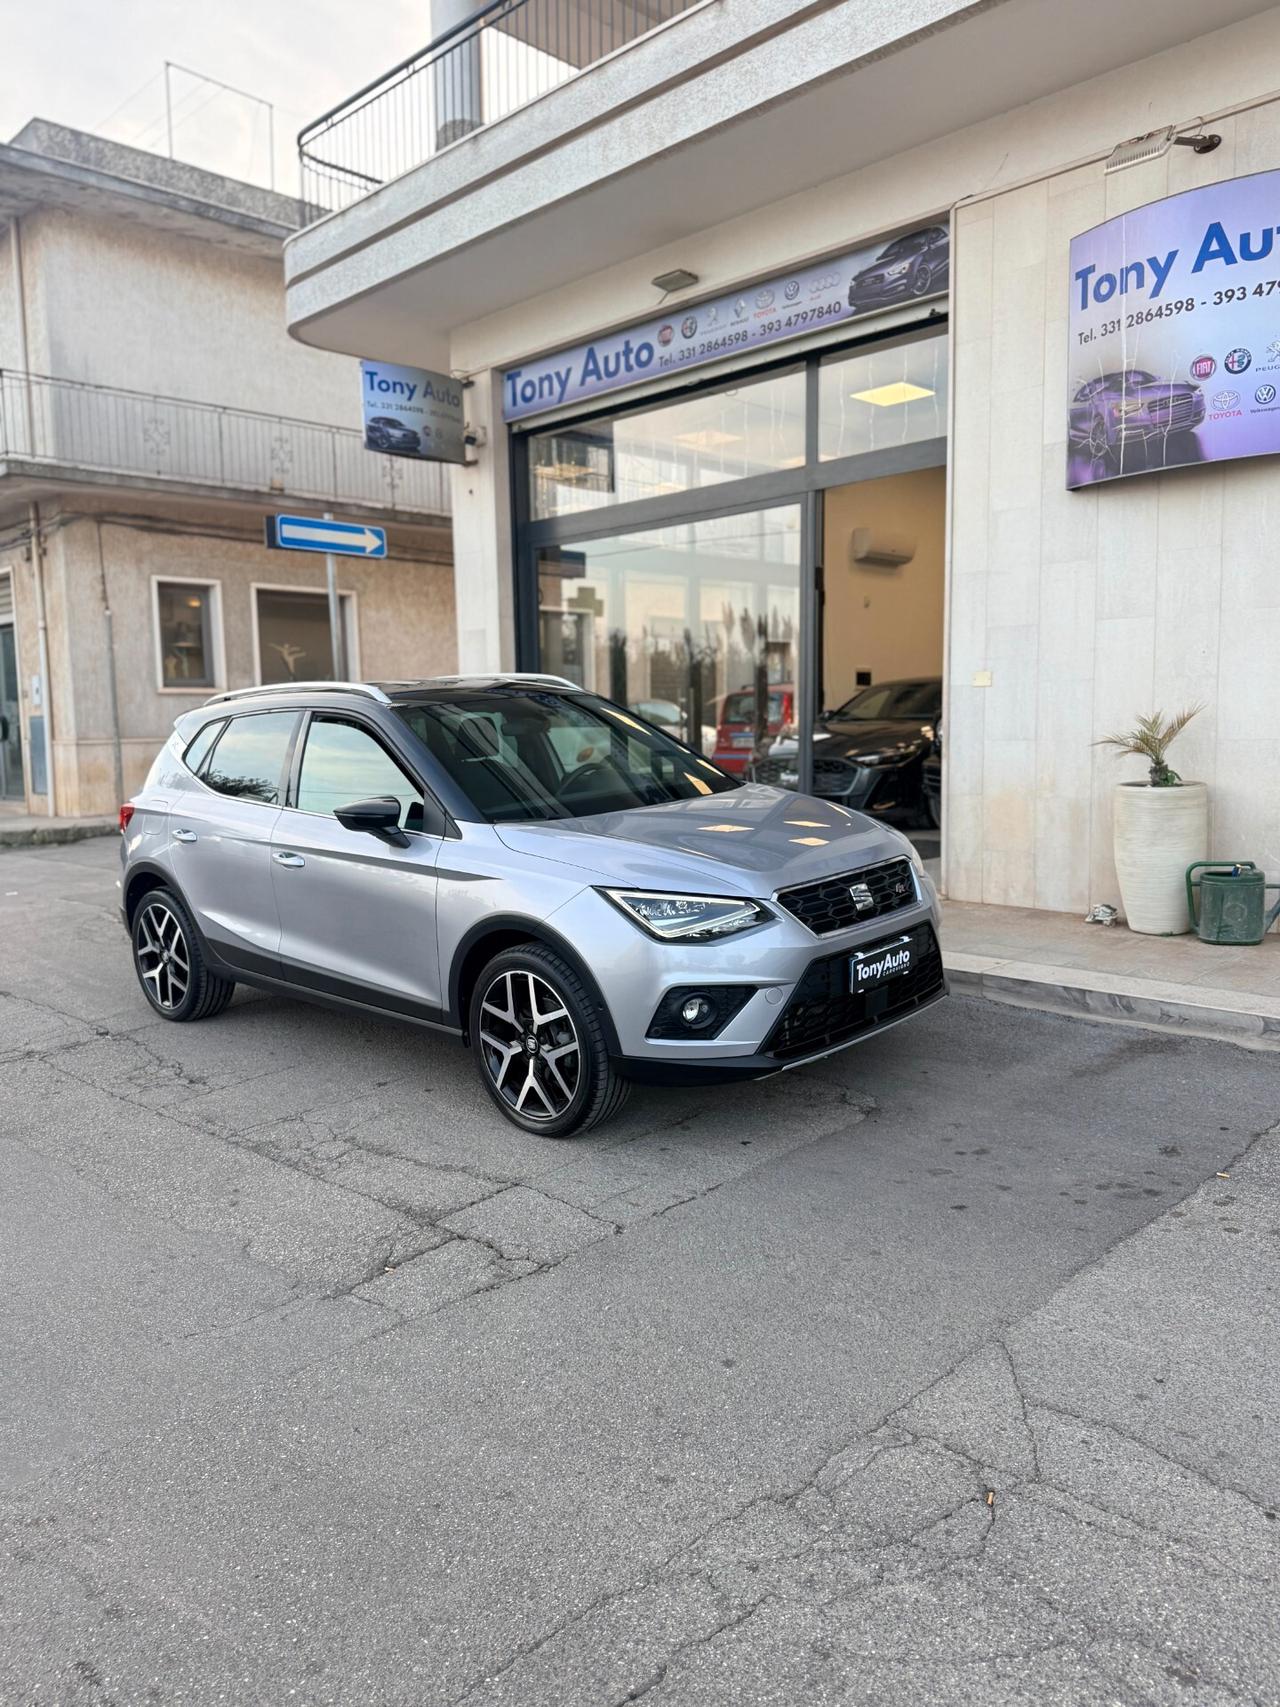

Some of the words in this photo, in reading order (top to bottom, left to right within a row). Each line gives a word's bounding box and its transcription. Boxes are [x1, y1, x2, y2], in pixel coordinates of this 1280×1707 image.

[1075, 249, 1179, 311] Tony
[1191, 221, 1280, 274] Au
[659, 354, 675, 367] Tel.
[679, 346, 696, 362] 331
[699, 330, 748, 355] 2864598
[760, 319, 781, 337] 393
[784, 301, 842, 328] 4797840
[1078, 328, 1097, 345] Tel.
[1101, 318, 1121, 337] 331
[1126, 298, 1195, 329] 2864598
[1213, 286, 1247, 306] 393
[1252, 280, 1280, 297] 47
[365, 371, 417, 401] Tony
[423, 380, 460, 408] Auto
[506, 366, 572, 407] Tony
[579, 340, 654, 387] Auto
[1196, 361, 1212, 376] FIAT
[1208, 410, 1242, 421] TOYOTA
[856, 950, 910, 981] TonyAuto
